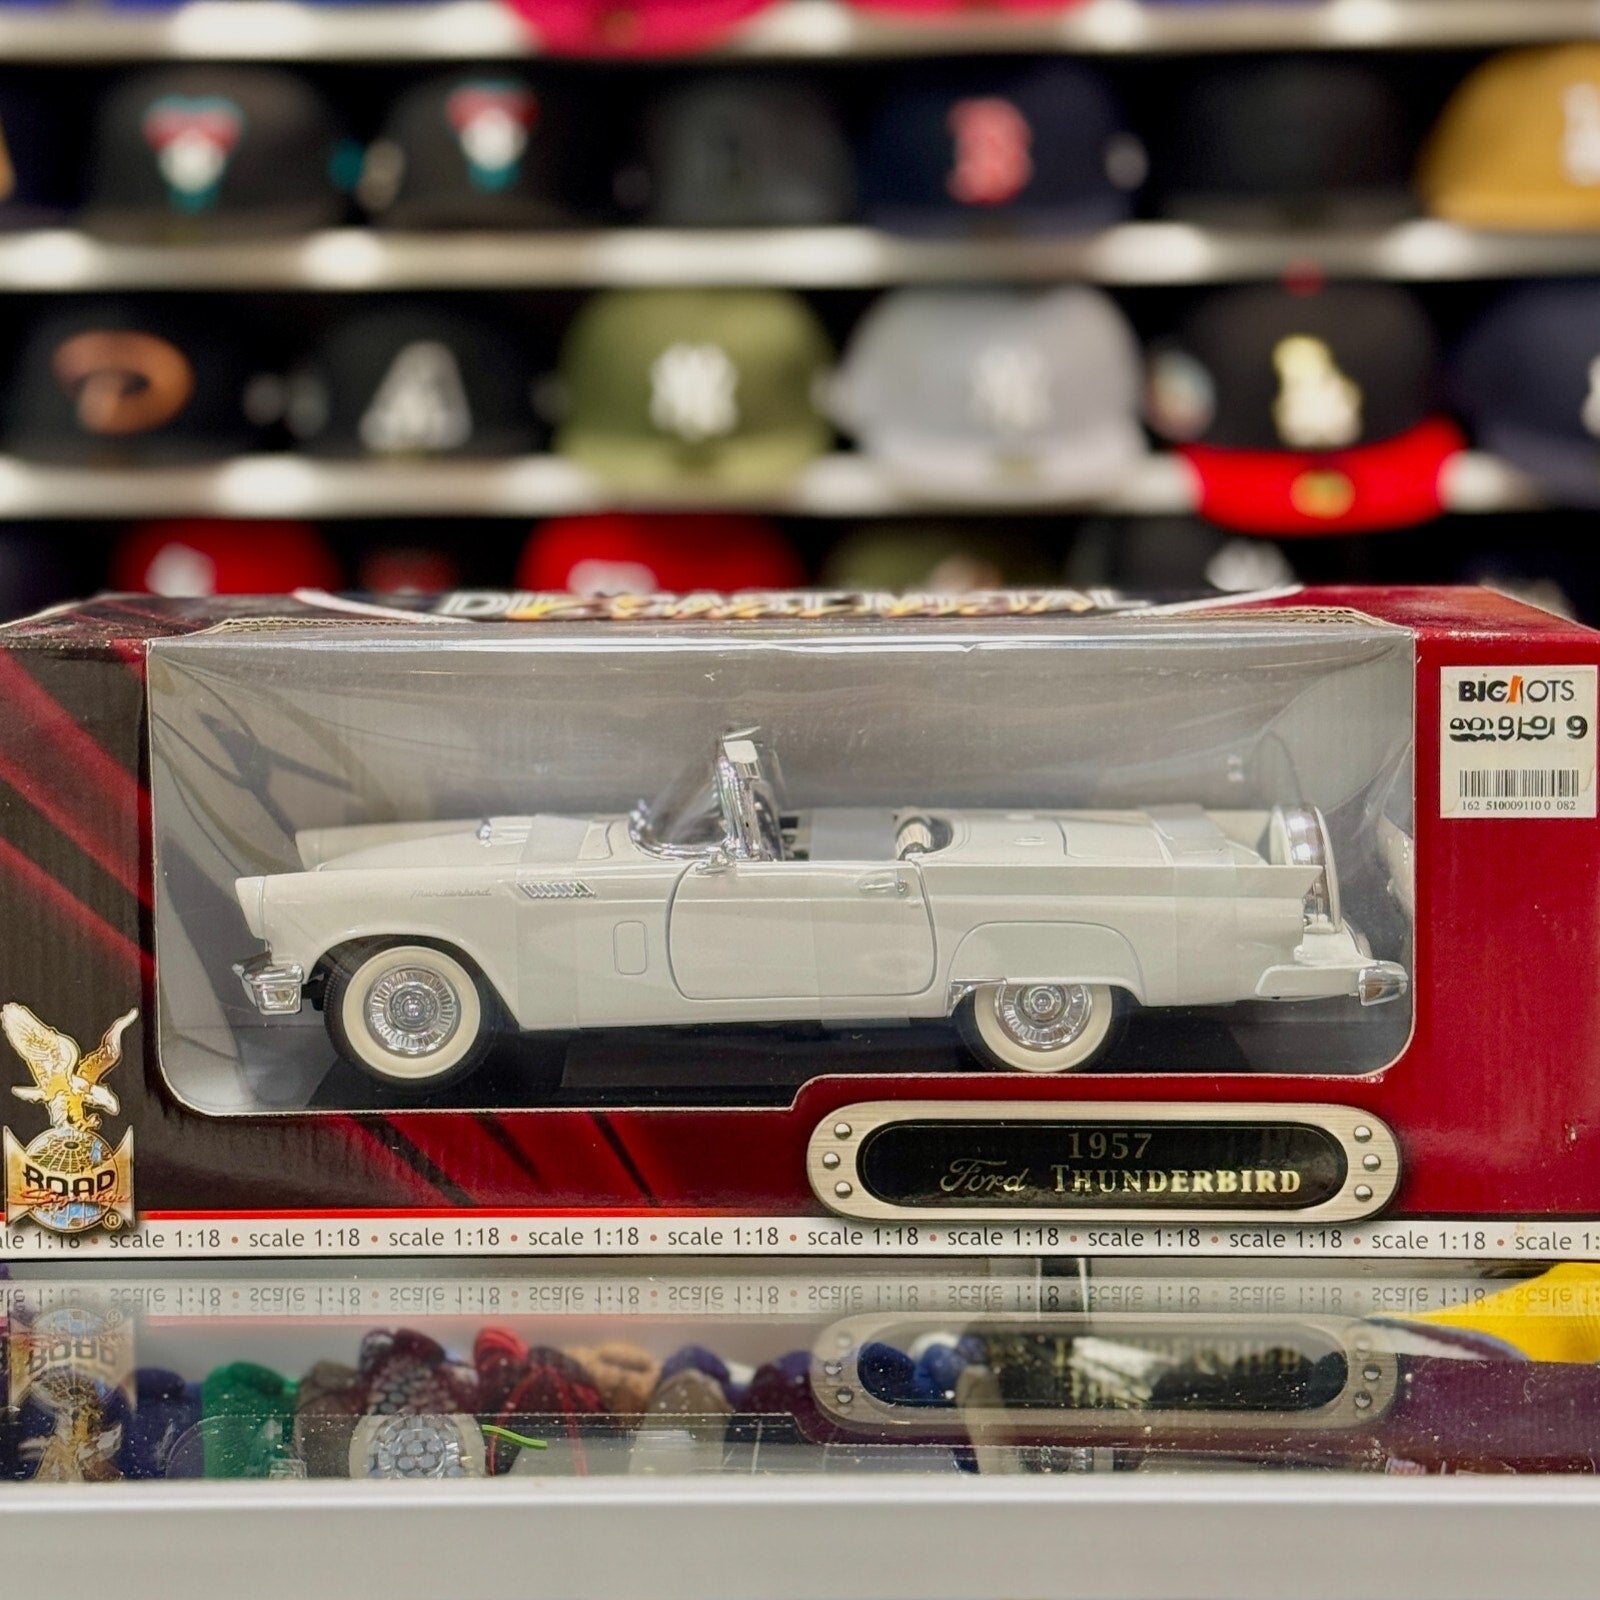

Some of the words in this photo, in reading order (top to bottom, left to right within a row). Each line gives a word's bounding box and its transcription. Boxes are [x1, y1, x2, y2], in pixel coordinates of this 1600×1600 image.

[1458, 680, 1508, 703] BIG
[1462, 800, 1481, 811] 162
[1556, 800, 1576, 811] 082
[1067, 1132, 1153, 1160] 1957
[22, 1163, 116, 1197] ROAD
[939, 1157, 1030, 1193] Ford
[1050, 1164, 1302, 1194] THUNDERBIRD
[110, 1229, 164, 1248] scale
[175, 1229, 221, 1248] 1:18
[250, 1228, 304, 1248] scale
[315, 1228, 361, 1248] 1:18
[389, 1227, 444, 1247] scale
[455, 1227, 501, 1247] 1:18
[528, 1227, 584, 1246] scale
[594, 1227, 639, 1246] 1:18
[667, 1227, 723, 1246] scale
[734, 1227, 779, 1246] 1:18
[808, 1227, 863, 1246] scale
[873, 1227, 919, 1246] 1:18
[948, 1228, 1003, 1247] scale
[1013, 1228, 1060, 1247] 1:18
[1088, 1228, 1144, 1248] scale
[1154, 1228, 1200, 1248] 1:18
[1229, 1229, 1286, 1249] scale
[1296, 1229, 1343, 1249] 1:18
[1372, 1230, 1428, 1250] scale
[1439, 1230, 1486, 1250] 1:18
[1514, 1231, 1573, 1251] scale
